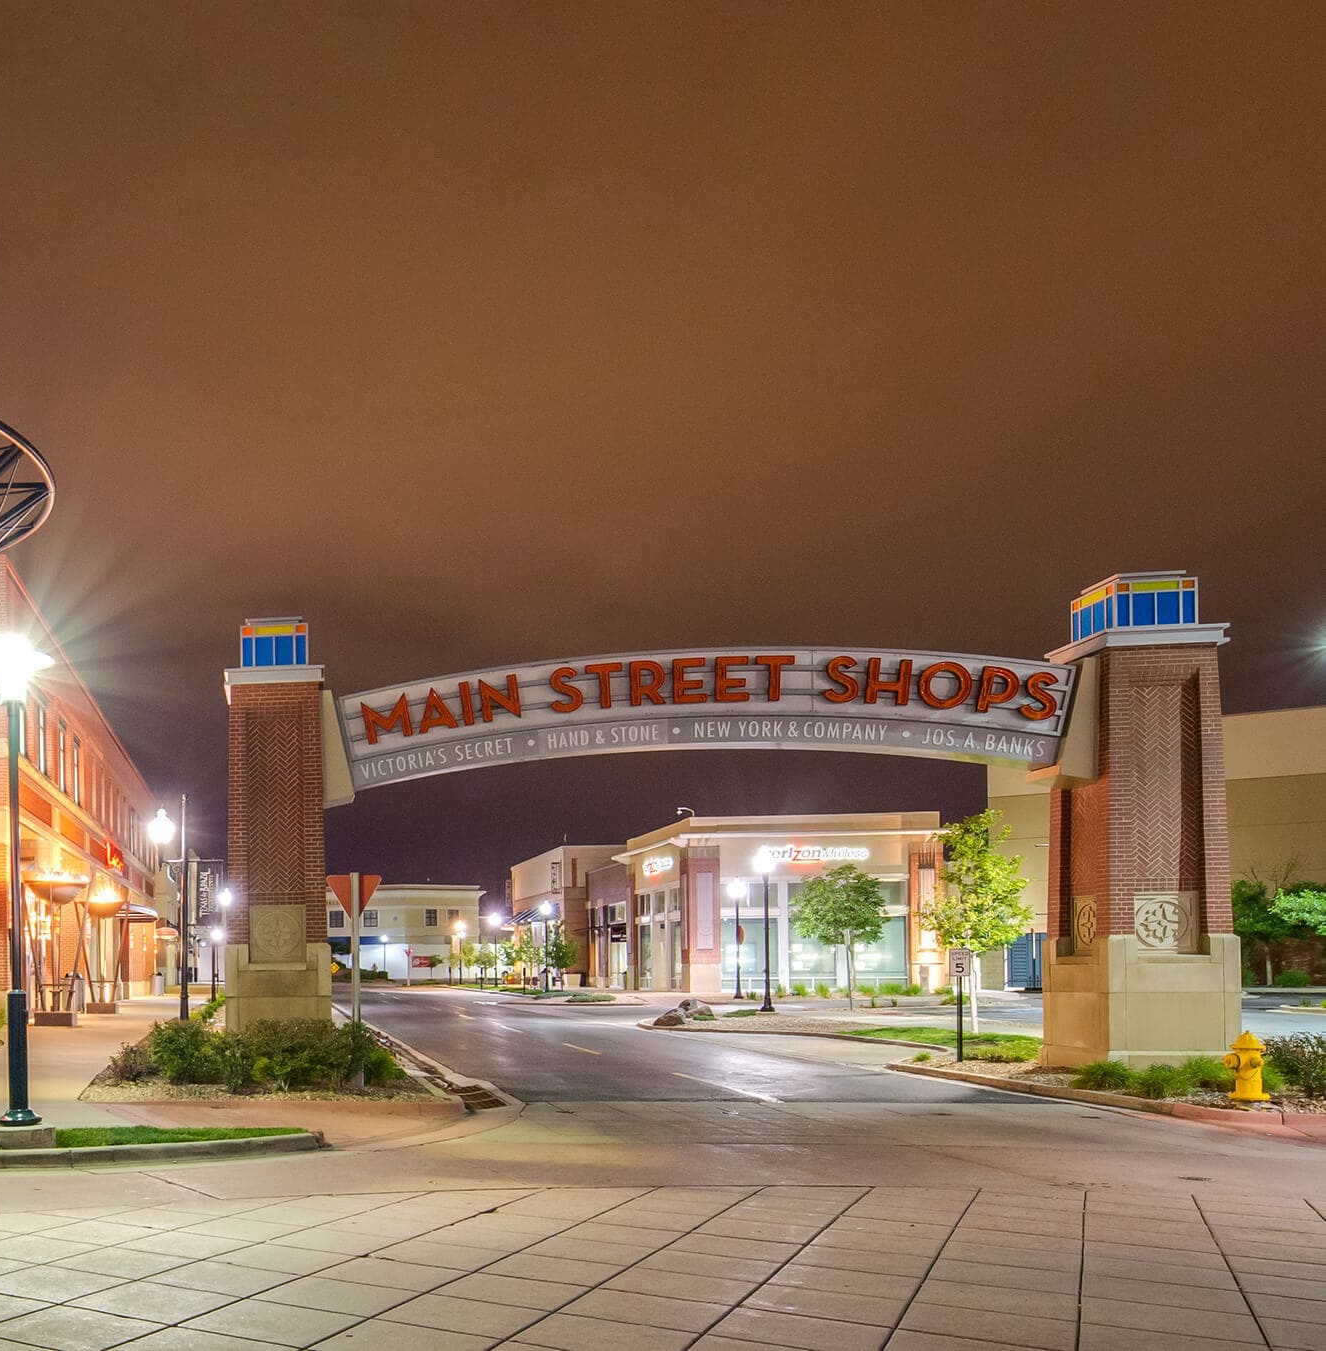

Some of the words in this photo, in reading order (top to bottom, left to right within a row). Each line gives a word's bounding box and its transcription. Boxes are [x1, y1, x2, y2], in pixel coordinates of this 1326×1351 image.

[361, 674, 522, 745] MAIN
[550, 655, 796, 714] STREET
[824, 655, 1060, 721] SHOPS
[547, 731, 590, 749] HAND
[595, 730, 606, 745] &
[611, 724, 659, 743] STONE
[694, 721, 731, 738] NEW
[738, 721, 783, 737] YORK
[787, 720, 799, 738] &
[803, 721, 888, 741] COMPANY
[922, 727, 959, 748] JOS.
[985, 739, 1046, 757] BANKS
[360, 748, 448, 779] VICTORIA'S
[454, 737, 514, 762] SECRET
[761, 847, 821, 861] erizon
[955, 962, 965, 973] 5
